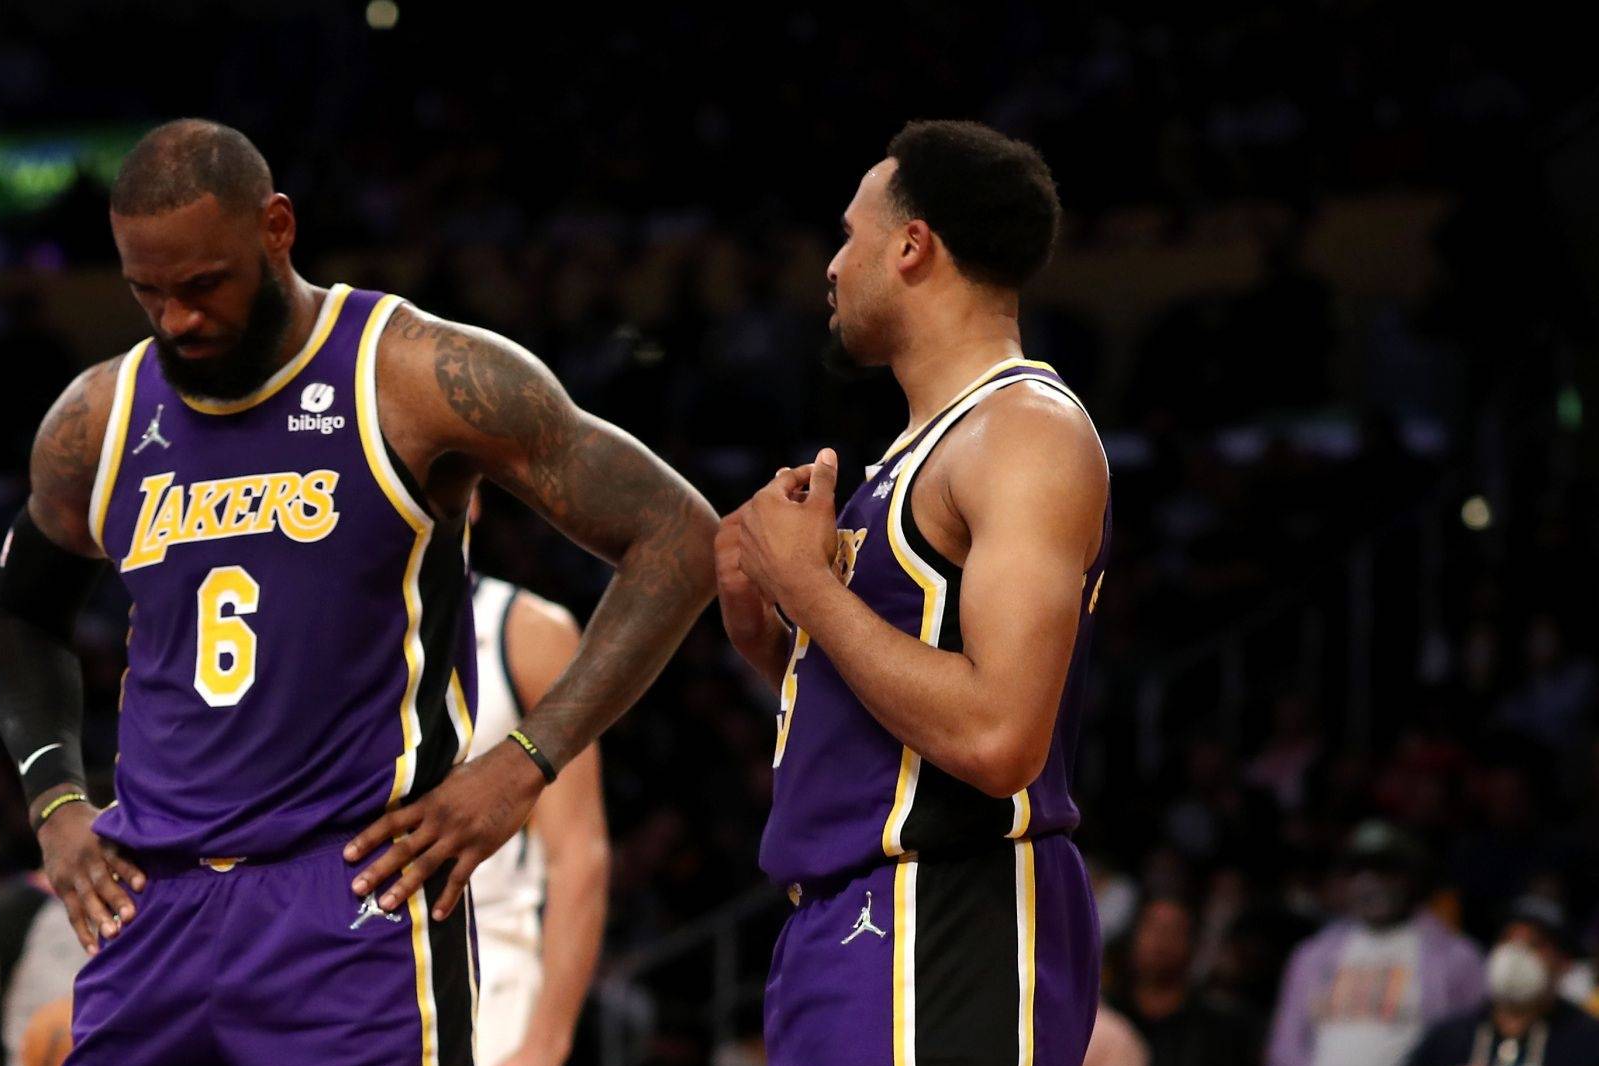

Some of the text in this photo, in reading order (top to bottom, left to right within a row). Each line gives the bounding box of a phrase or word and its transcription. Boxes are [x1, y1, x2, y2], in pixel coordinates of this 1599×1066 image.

[287, 414, 346, 435] bibigo
[120, 468, 341, 573] LAKERS
[193, 565, 261, 708] 6
